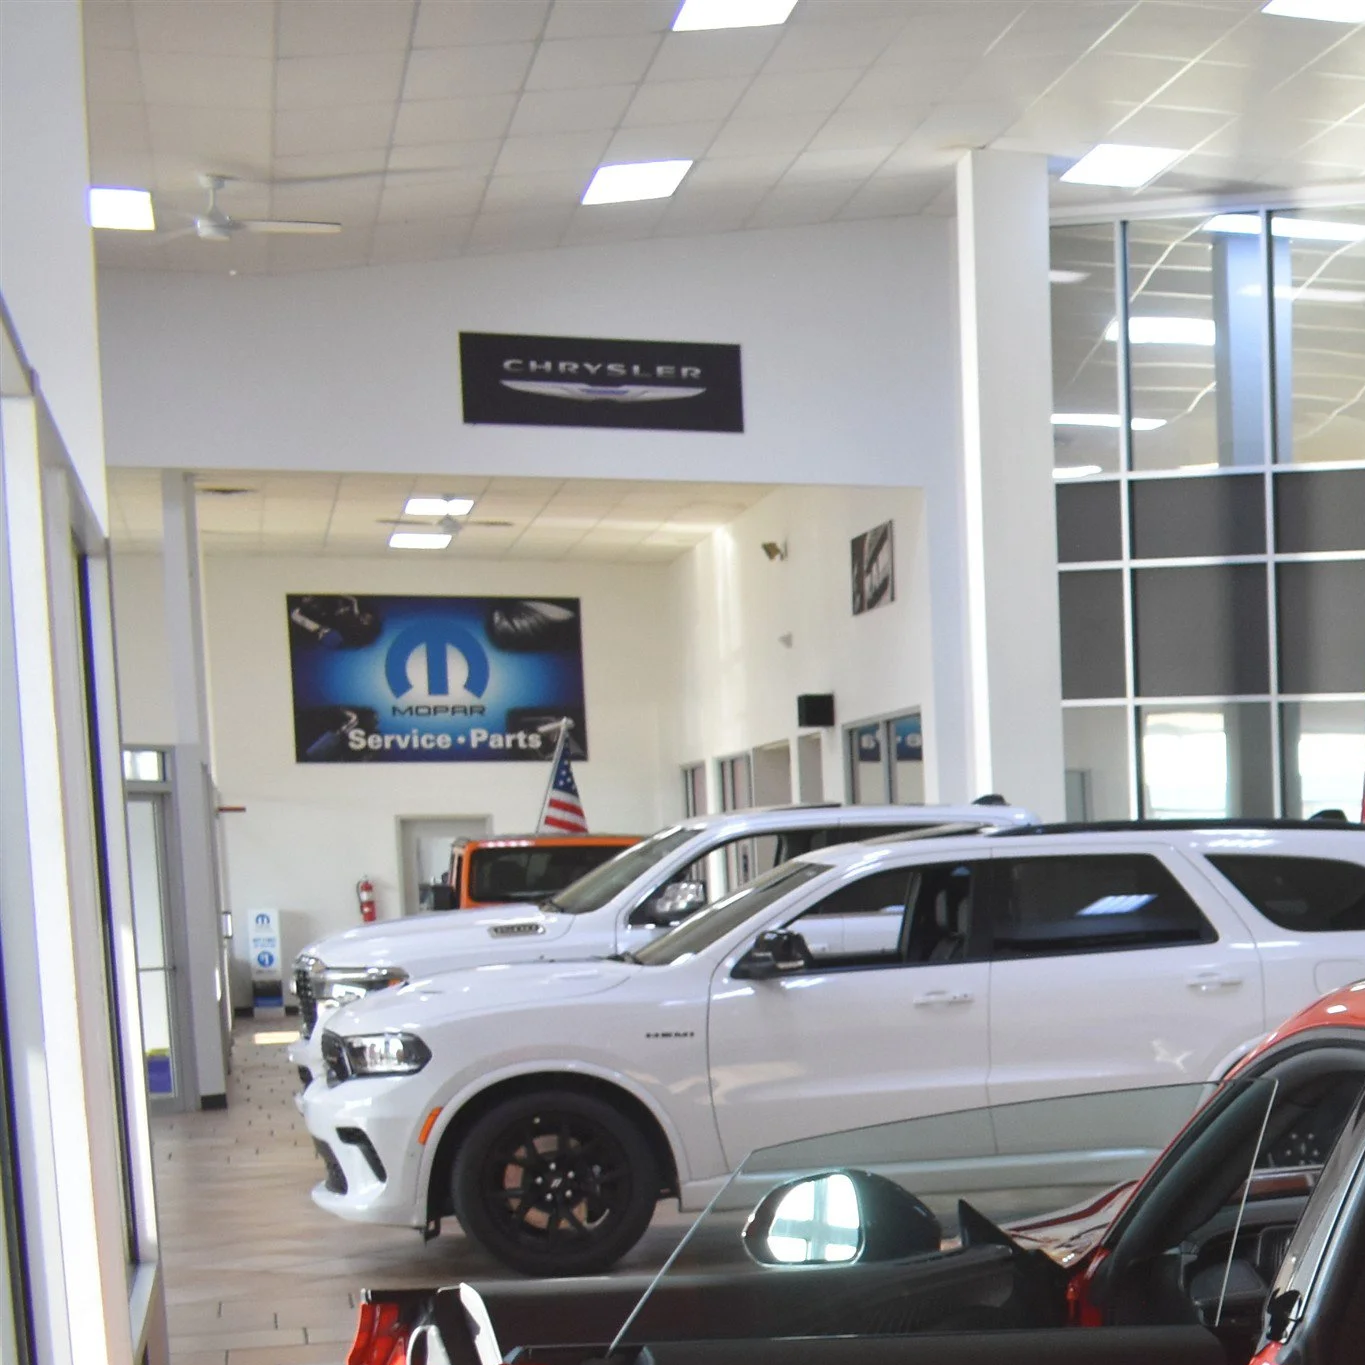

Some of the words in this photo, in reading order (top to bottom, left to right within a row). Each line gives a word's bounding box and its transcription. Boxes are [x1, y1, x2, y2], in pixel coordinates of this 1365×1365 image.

[503, 359, 702, 379] CHRYSLER
[392, 704, 486, 717] MOPAR
[348, 728, 452, 750] Service
[470, 728, 542, 749] Parts
